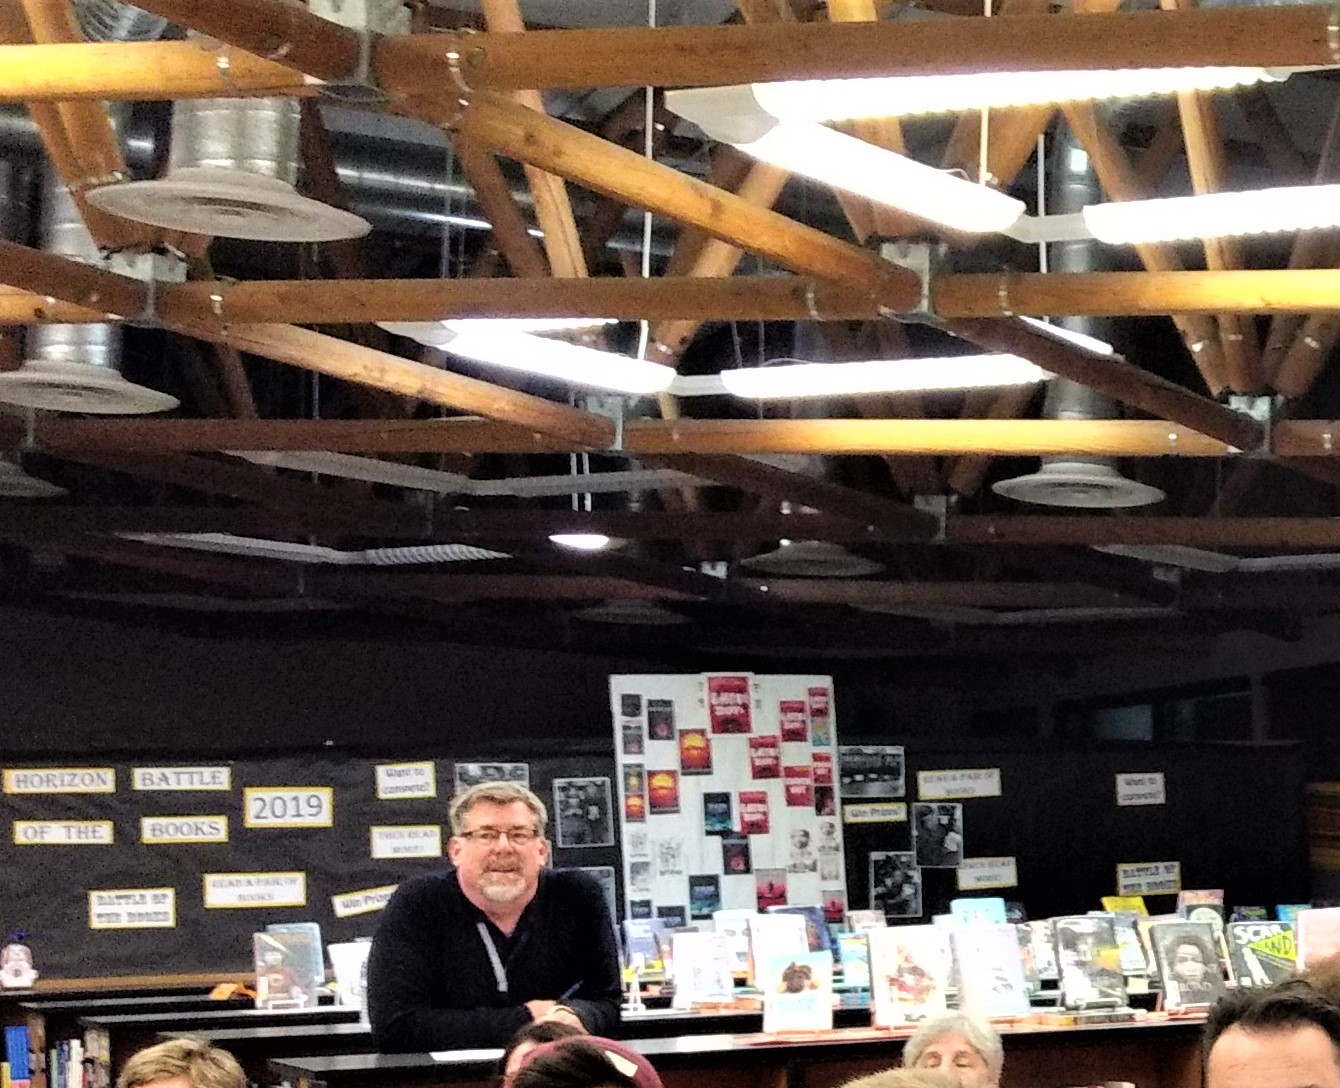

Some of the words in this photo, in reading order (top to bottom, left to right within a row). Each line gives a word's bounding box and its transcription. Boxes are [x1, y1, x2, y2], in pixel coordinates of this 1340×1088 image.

[15, 770, 109, 789] HORIZON
[140, 769, 225, 788] BATTLE
[253, 794, 324, 821] 2019
[23, 825, 49, 841] OF
[62, 824, 106, 840] THE
[149, 821, 221, 838] BOOKS
